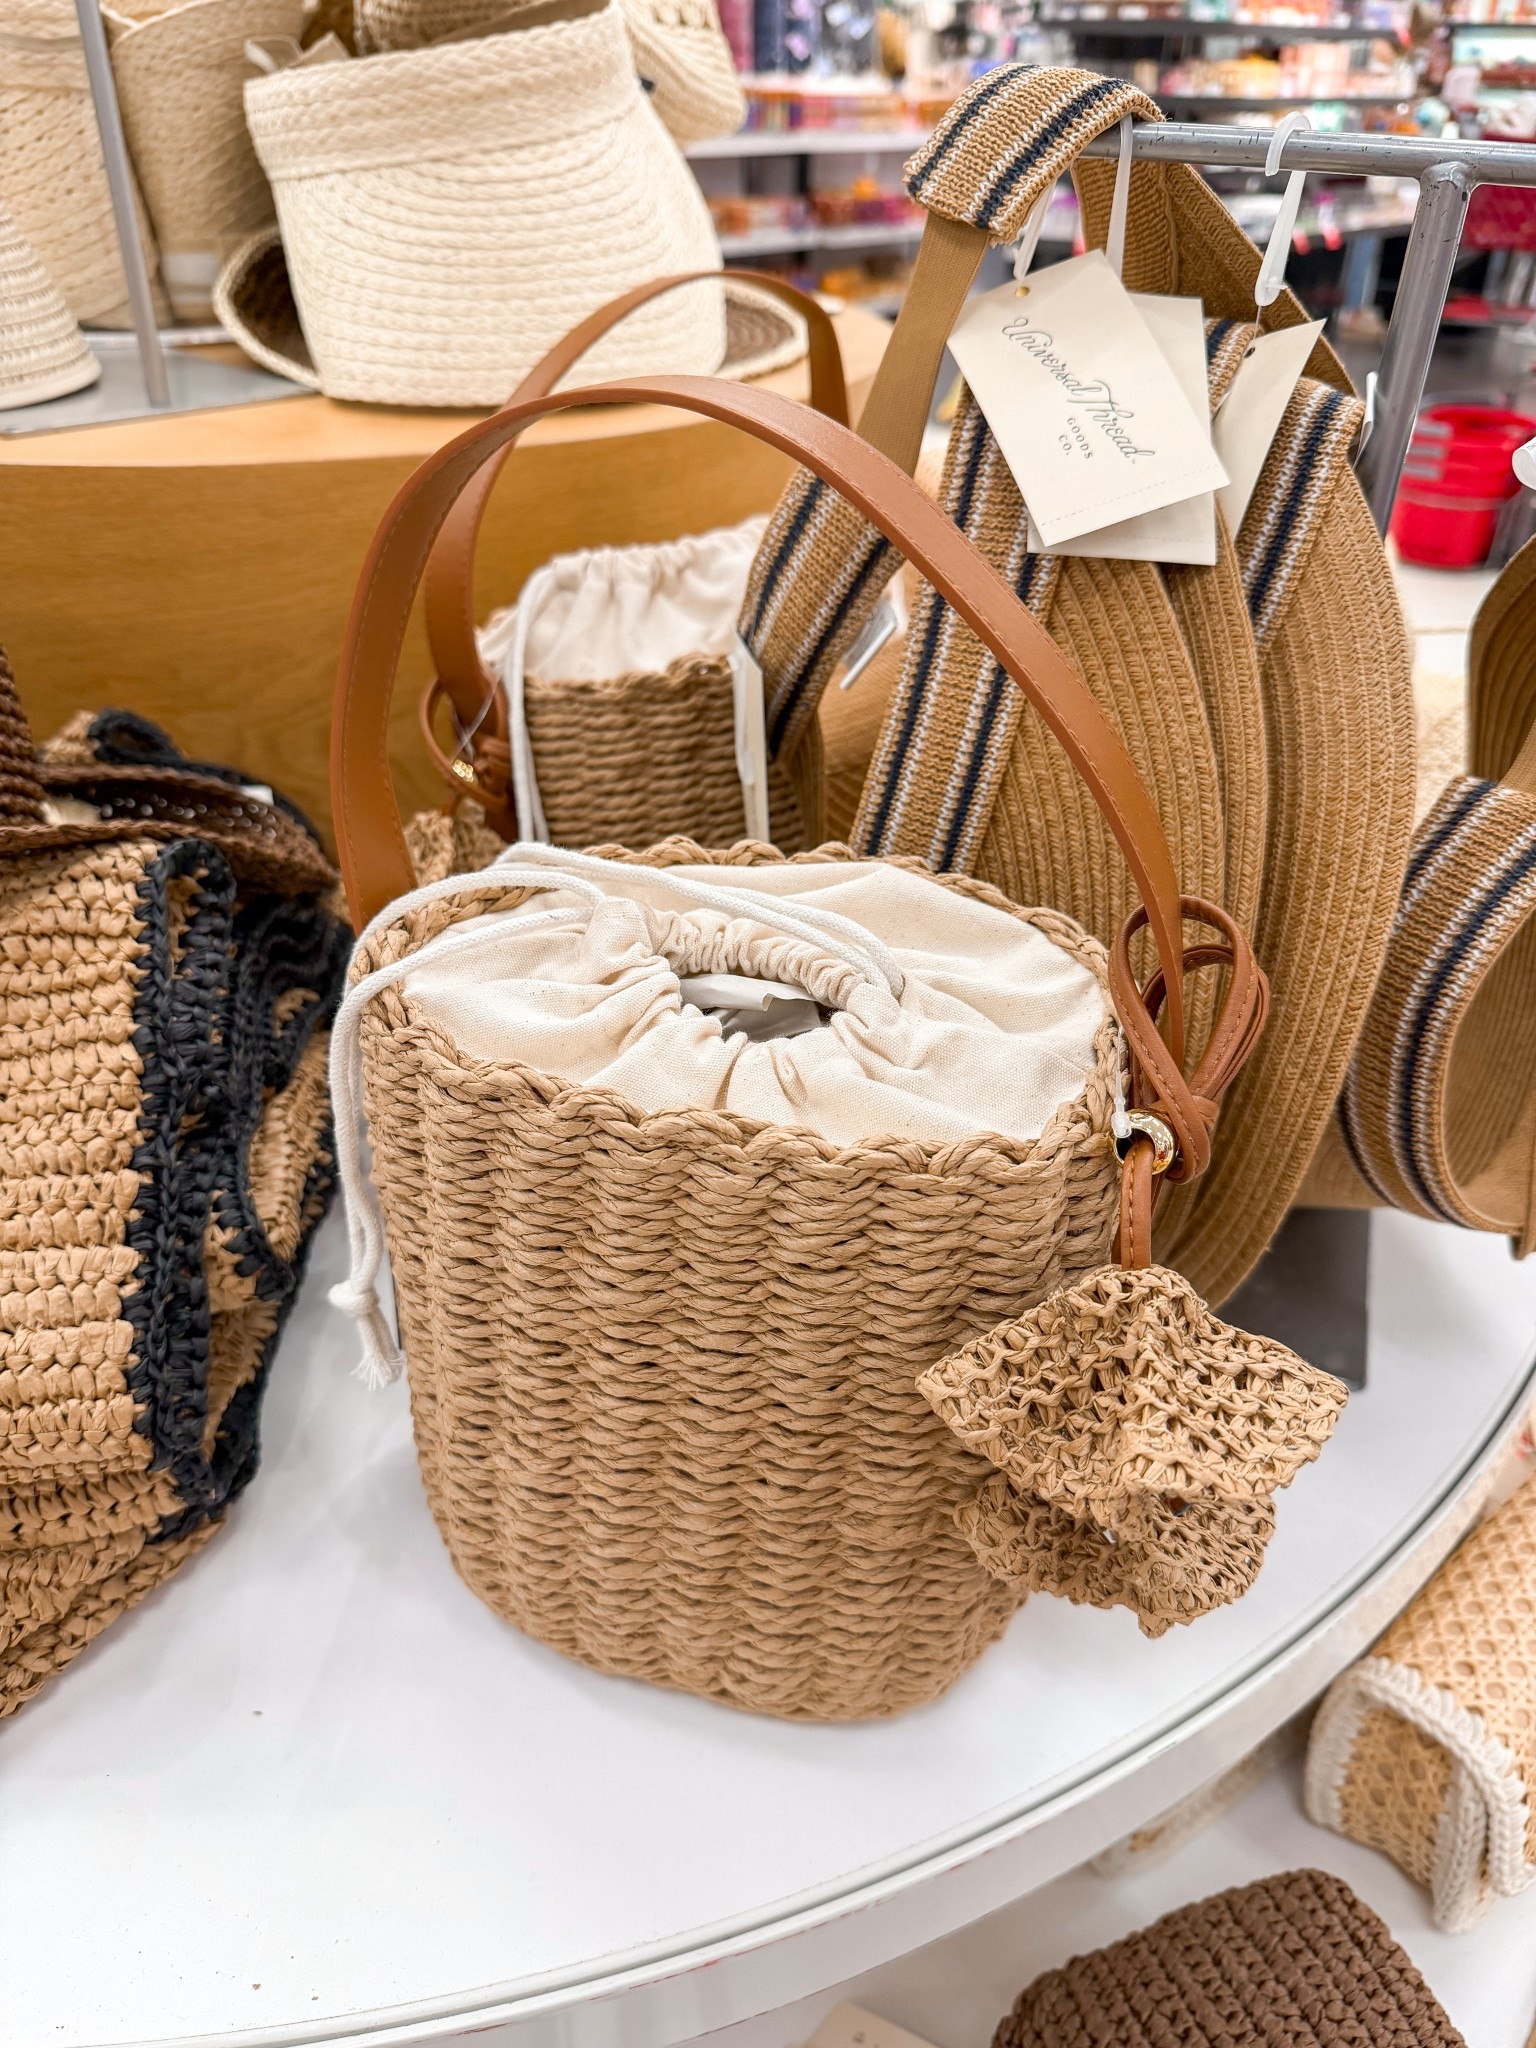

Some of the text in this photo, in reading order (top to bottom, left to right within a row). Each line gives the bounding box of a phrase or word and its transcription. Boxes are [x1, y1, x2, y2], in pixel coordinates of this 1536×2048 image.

[1002, 317, 1102, 396] Universal
[1058, 435, 1072, 456] CO.
[1067, 417, 1093, 459] GOODS
